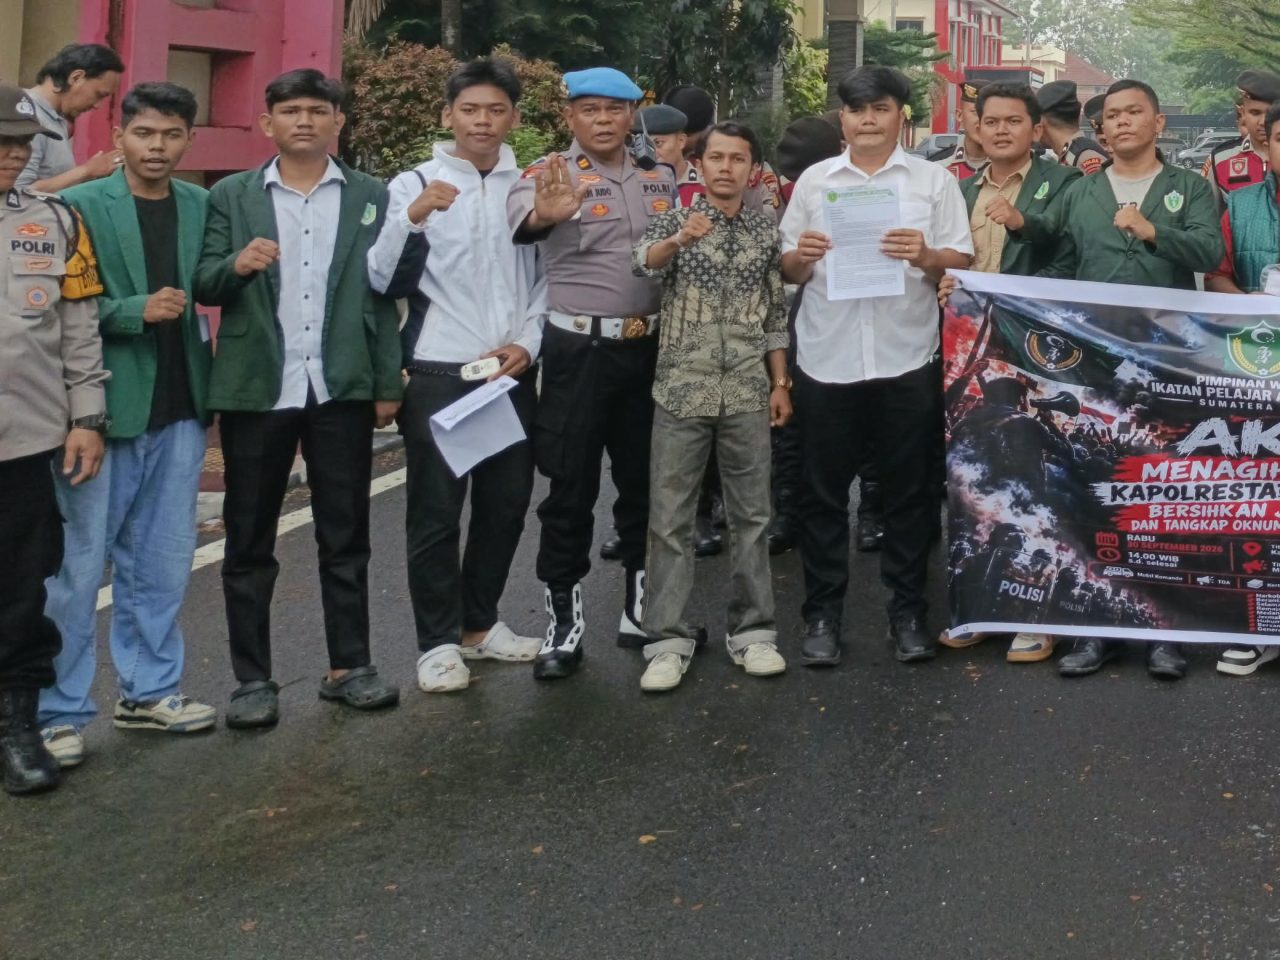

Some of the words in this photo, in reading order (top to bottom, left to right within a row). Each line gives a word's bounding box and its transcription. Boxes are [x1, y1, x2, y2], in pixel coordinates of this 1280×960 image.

[643, 184, 670, 194] POLRI
[11, 240, 55, 255] POLRI
[1196, 375, 1265, 389] PIMPINAN
[1151, 382, 1202, 396] IKATAN
[1206, 387, 1272, 401] PELAJAR
[1200, 398, 1273, 411] SUMATERA
[1148, 503, 1267, 519] BERSIHKAN
[1131, 519, 1159, 531] DAN
[1163, 519, 1229, 531] TANGKAP
[1126, 534, 1156, 542] RABU
[1128, 551, 1156, 560] 14.00
[1158, 554, 1180, 562] WIB
[1146, 559, 1178, 568] selesai
[998, 580, 1045, 603] POLISI
